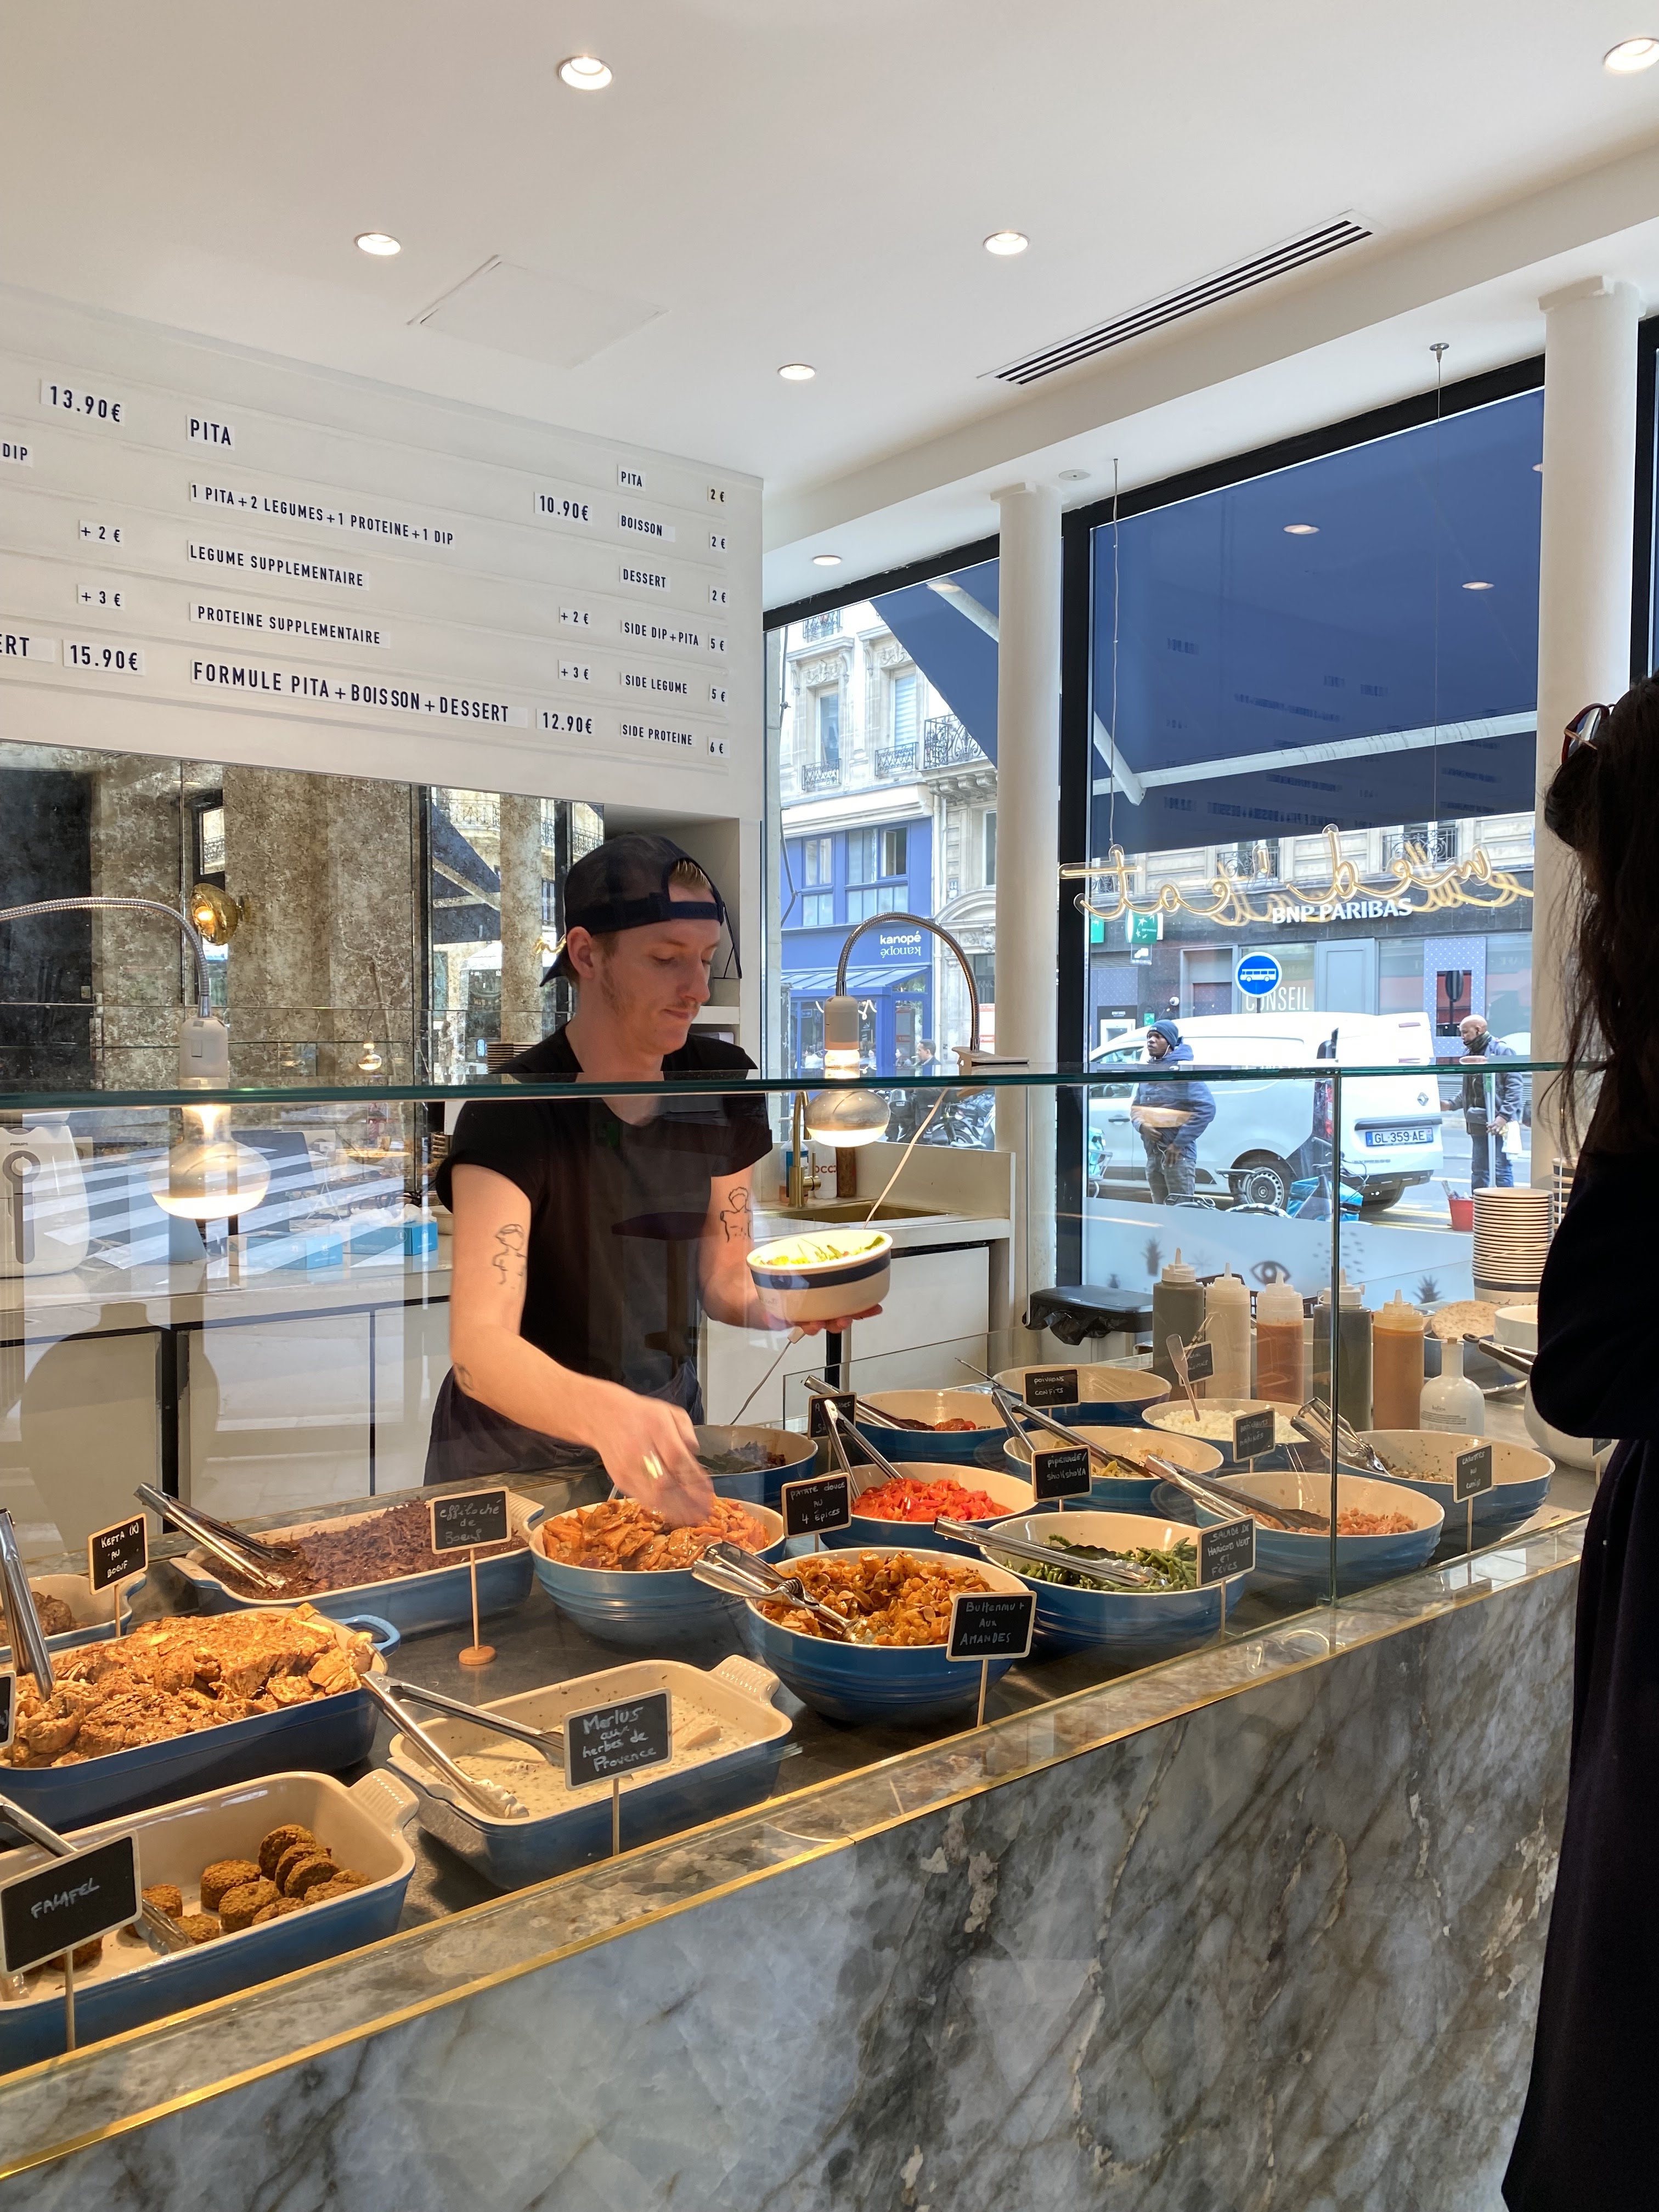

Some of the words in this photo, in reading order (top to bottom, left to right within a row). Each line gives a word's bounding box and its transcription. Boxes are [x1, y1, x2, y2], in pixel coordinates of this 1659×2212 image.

[50, 386, 121, 422] 13.90€
[190, 419, 232, 446] PITA
[2, 443, 28, 461] DIP
[621, 471, 642, 488] PITA
[540, 495, 589, 521] 10.90€
[621, 515, 662, 537] BOISSON
[434, 530, 453, 545] DIP
[190, 545, 244, 567] LEGUME
[250, 555, 363, 586] SUPPLEMENTAIRE
[623, 568, 666, 588] DESSERT
[198, 606, 263, 628] PROTEINE
[269, 616, 380, 645] SUPPLEMENTAIRE
[624, 622, 647, 637] SIDE
[0, 633, 30, 657] RT
[70, 645, 138, 671] 15.90€
[194, 661, 281, 691] FORMULE
[625, 674, 647, 688] SIDE
[651, 678, 687, 694] LEGUME
[543, 712, 592, 735] 12.90€
[622, 724, 644, 738] SIDE
[648, 728, 692, 746] PROTEINE
[1272, 905, 1315, 924] BNP
[1319, 898, 1413, 921] PARIBAS
[880, 930, 922, 945] kanopé
[880, 946, 922, 958] kanopé
[460, 1518, 476, 1527] de
[802, 1513, 809, 1524] 4
[101, 1531, 125, 1548] KEFTA
[1210, 1527, 1239, 1543] SALADE
[111, 1549, 120, 1560] AU
[960, 1632, 1012, 1646] AMANDES
[582, 1739, 624, 1758] herbes
[630, 1729, 649, 1743] de
[593, 1747, 657, 1772] Provence
[31, 1877, 100, 1919] FALAFEL
